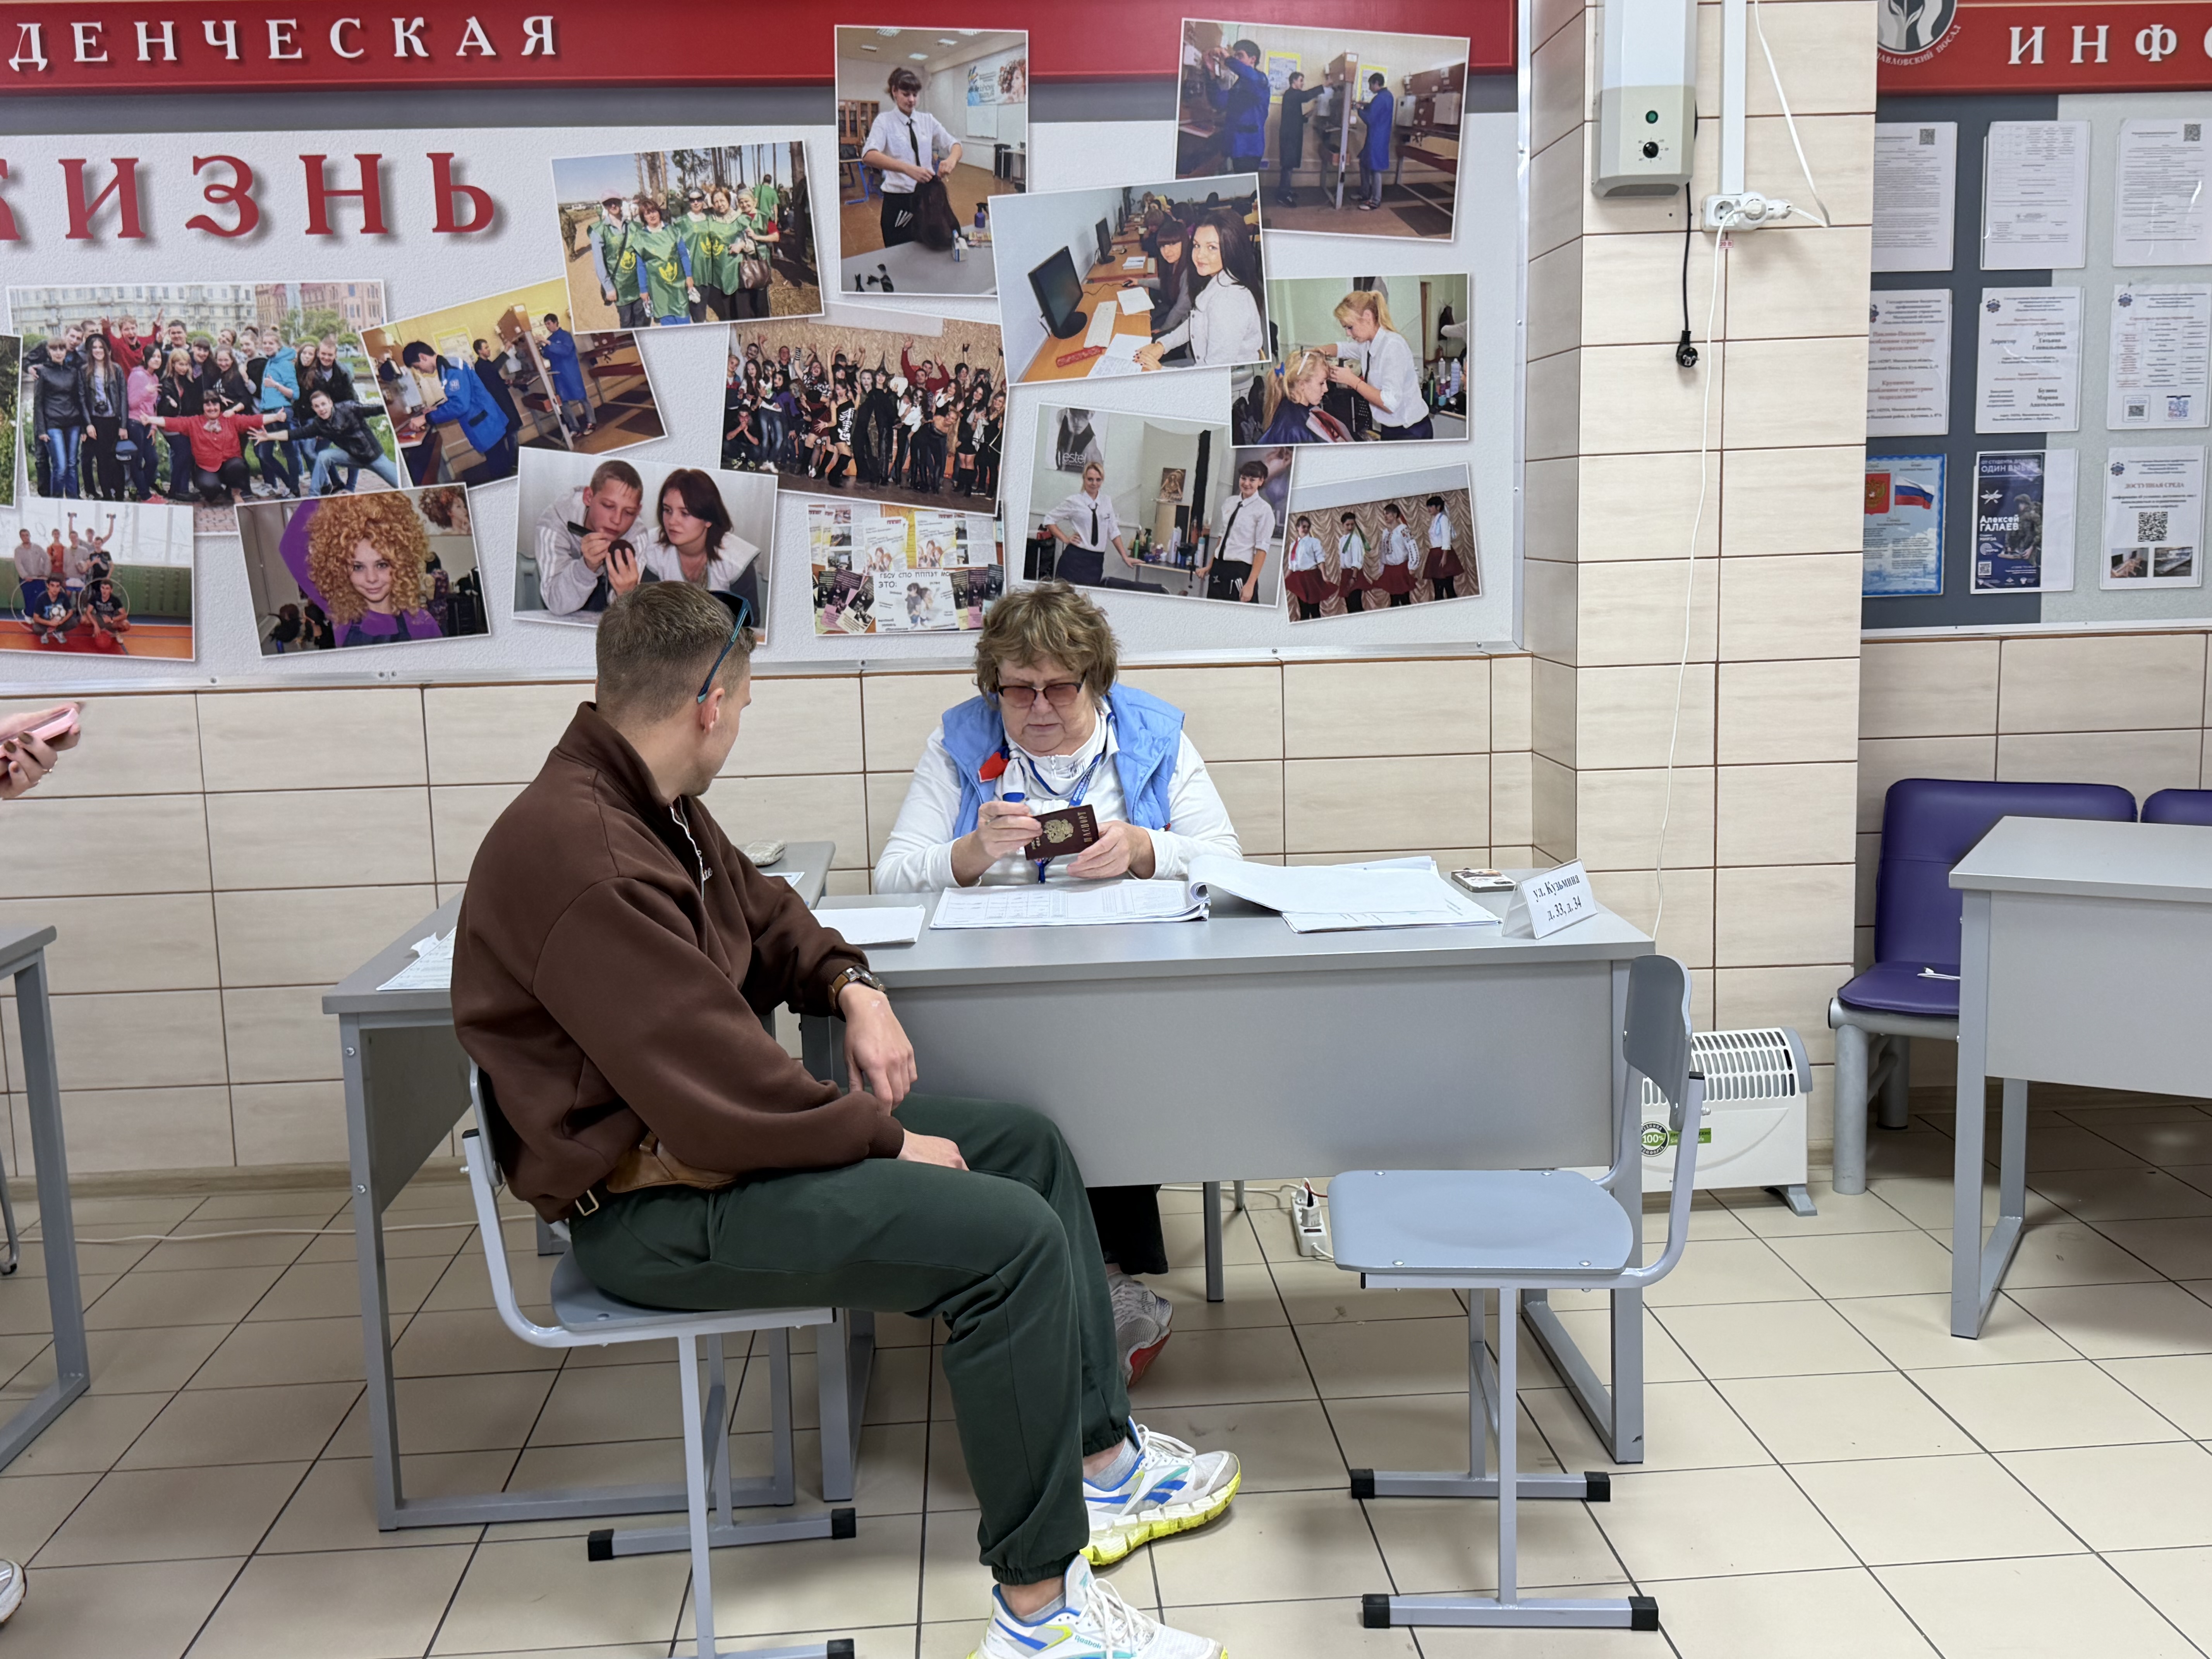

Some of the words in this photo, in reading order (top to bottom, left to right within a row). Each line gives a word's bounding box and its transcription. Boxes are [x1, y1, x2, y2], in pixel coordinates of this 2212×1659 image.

[9, 15, 556, 72] ДЕНЧЕСКАЯ
[2008, 24, 2212, 65] ИНФ
[1981, 465, 2006, 473] ОДИН
[1980, 514, 2020, 523] Алексей
[1980, 523, 2019, 532] ГАЛАЕВ
[1533, 888, 1546, 903] ул.
[1544, 874, 1580, 896] Кузьмина
[1547, 910, 1555, 921] д.
[1566, 903, 1574, 914] д.
[1573, 895, 1582, 910] 34
[1642, 1134, 1664, 1143] 100%
